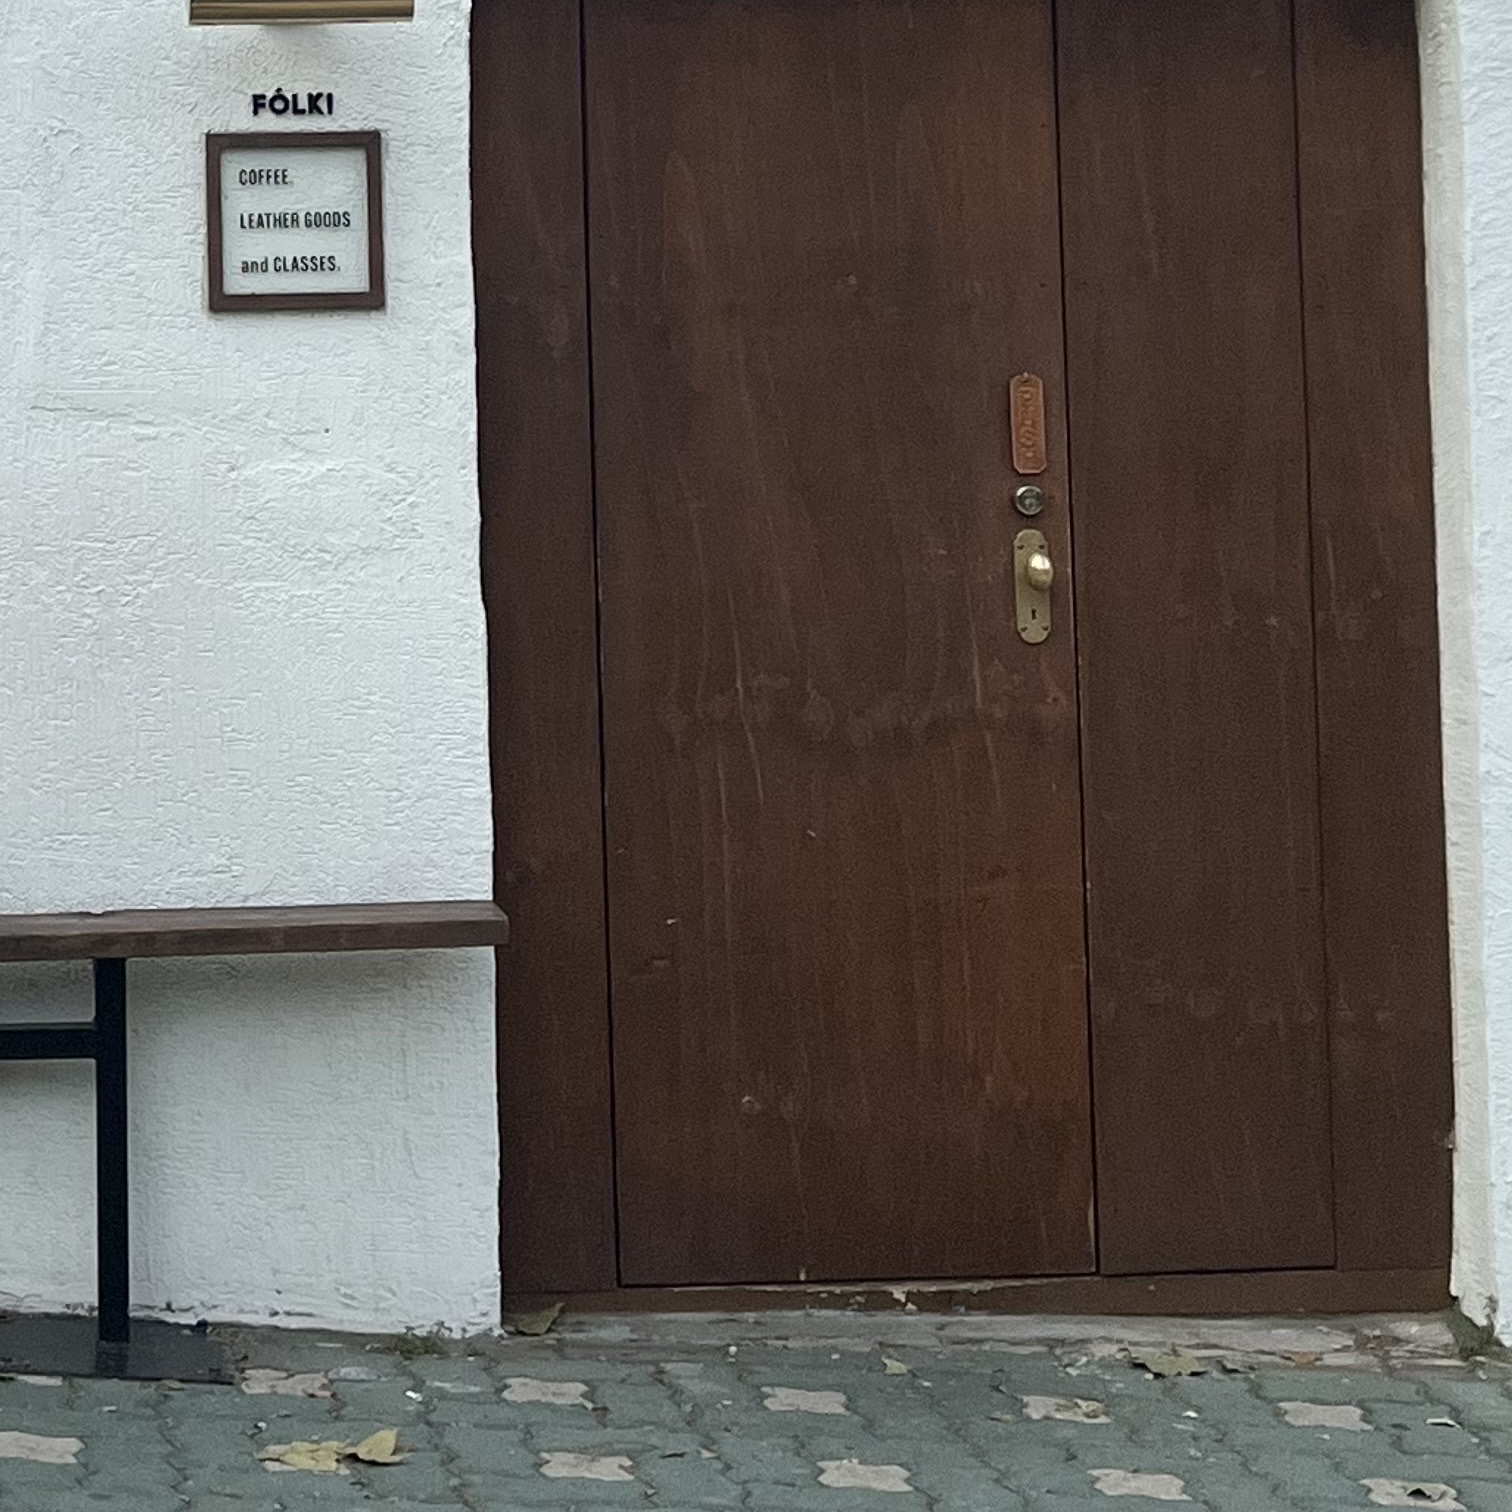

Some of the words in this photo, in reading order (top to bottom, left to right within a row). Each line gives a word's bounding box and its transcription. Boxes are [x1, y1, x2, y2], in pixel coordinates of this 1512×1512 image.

[251, 87, 334, 117] FÓLKI
[239, 212, 300, 230] LEATHER
[304, 211, 351, 229] GOODS
[241, 256, 269, 274] and
[273, 255, 341, 274] CLASSES.
